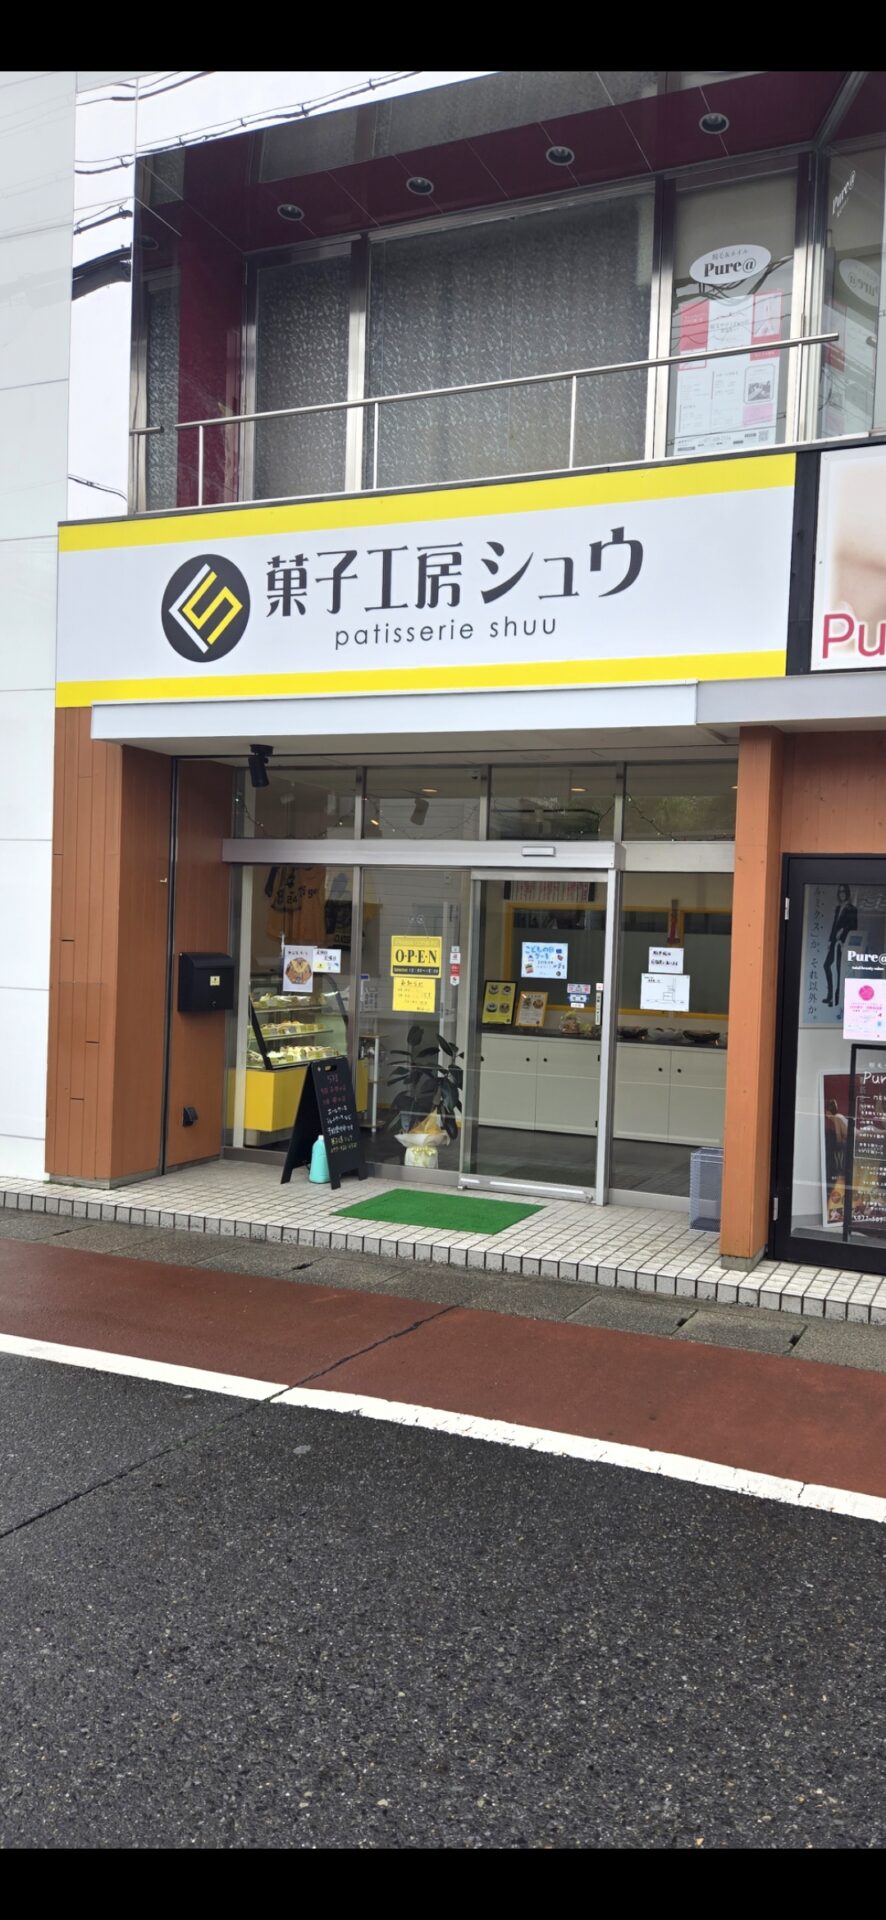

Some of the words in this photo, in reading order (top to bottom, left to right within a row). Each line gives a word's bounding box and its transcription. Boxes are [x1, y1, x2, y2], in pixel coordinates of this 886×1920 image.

[704, 257, 757, 277] Pure@
[266, 526, 644, 620] 菓子工房シュウ
[335, 619, 474, 650] patisserie
[489, 615, 557, 638] shuu
[823, 613, 886, 659] Pu
[847, 950, 886, 966] Pure@
